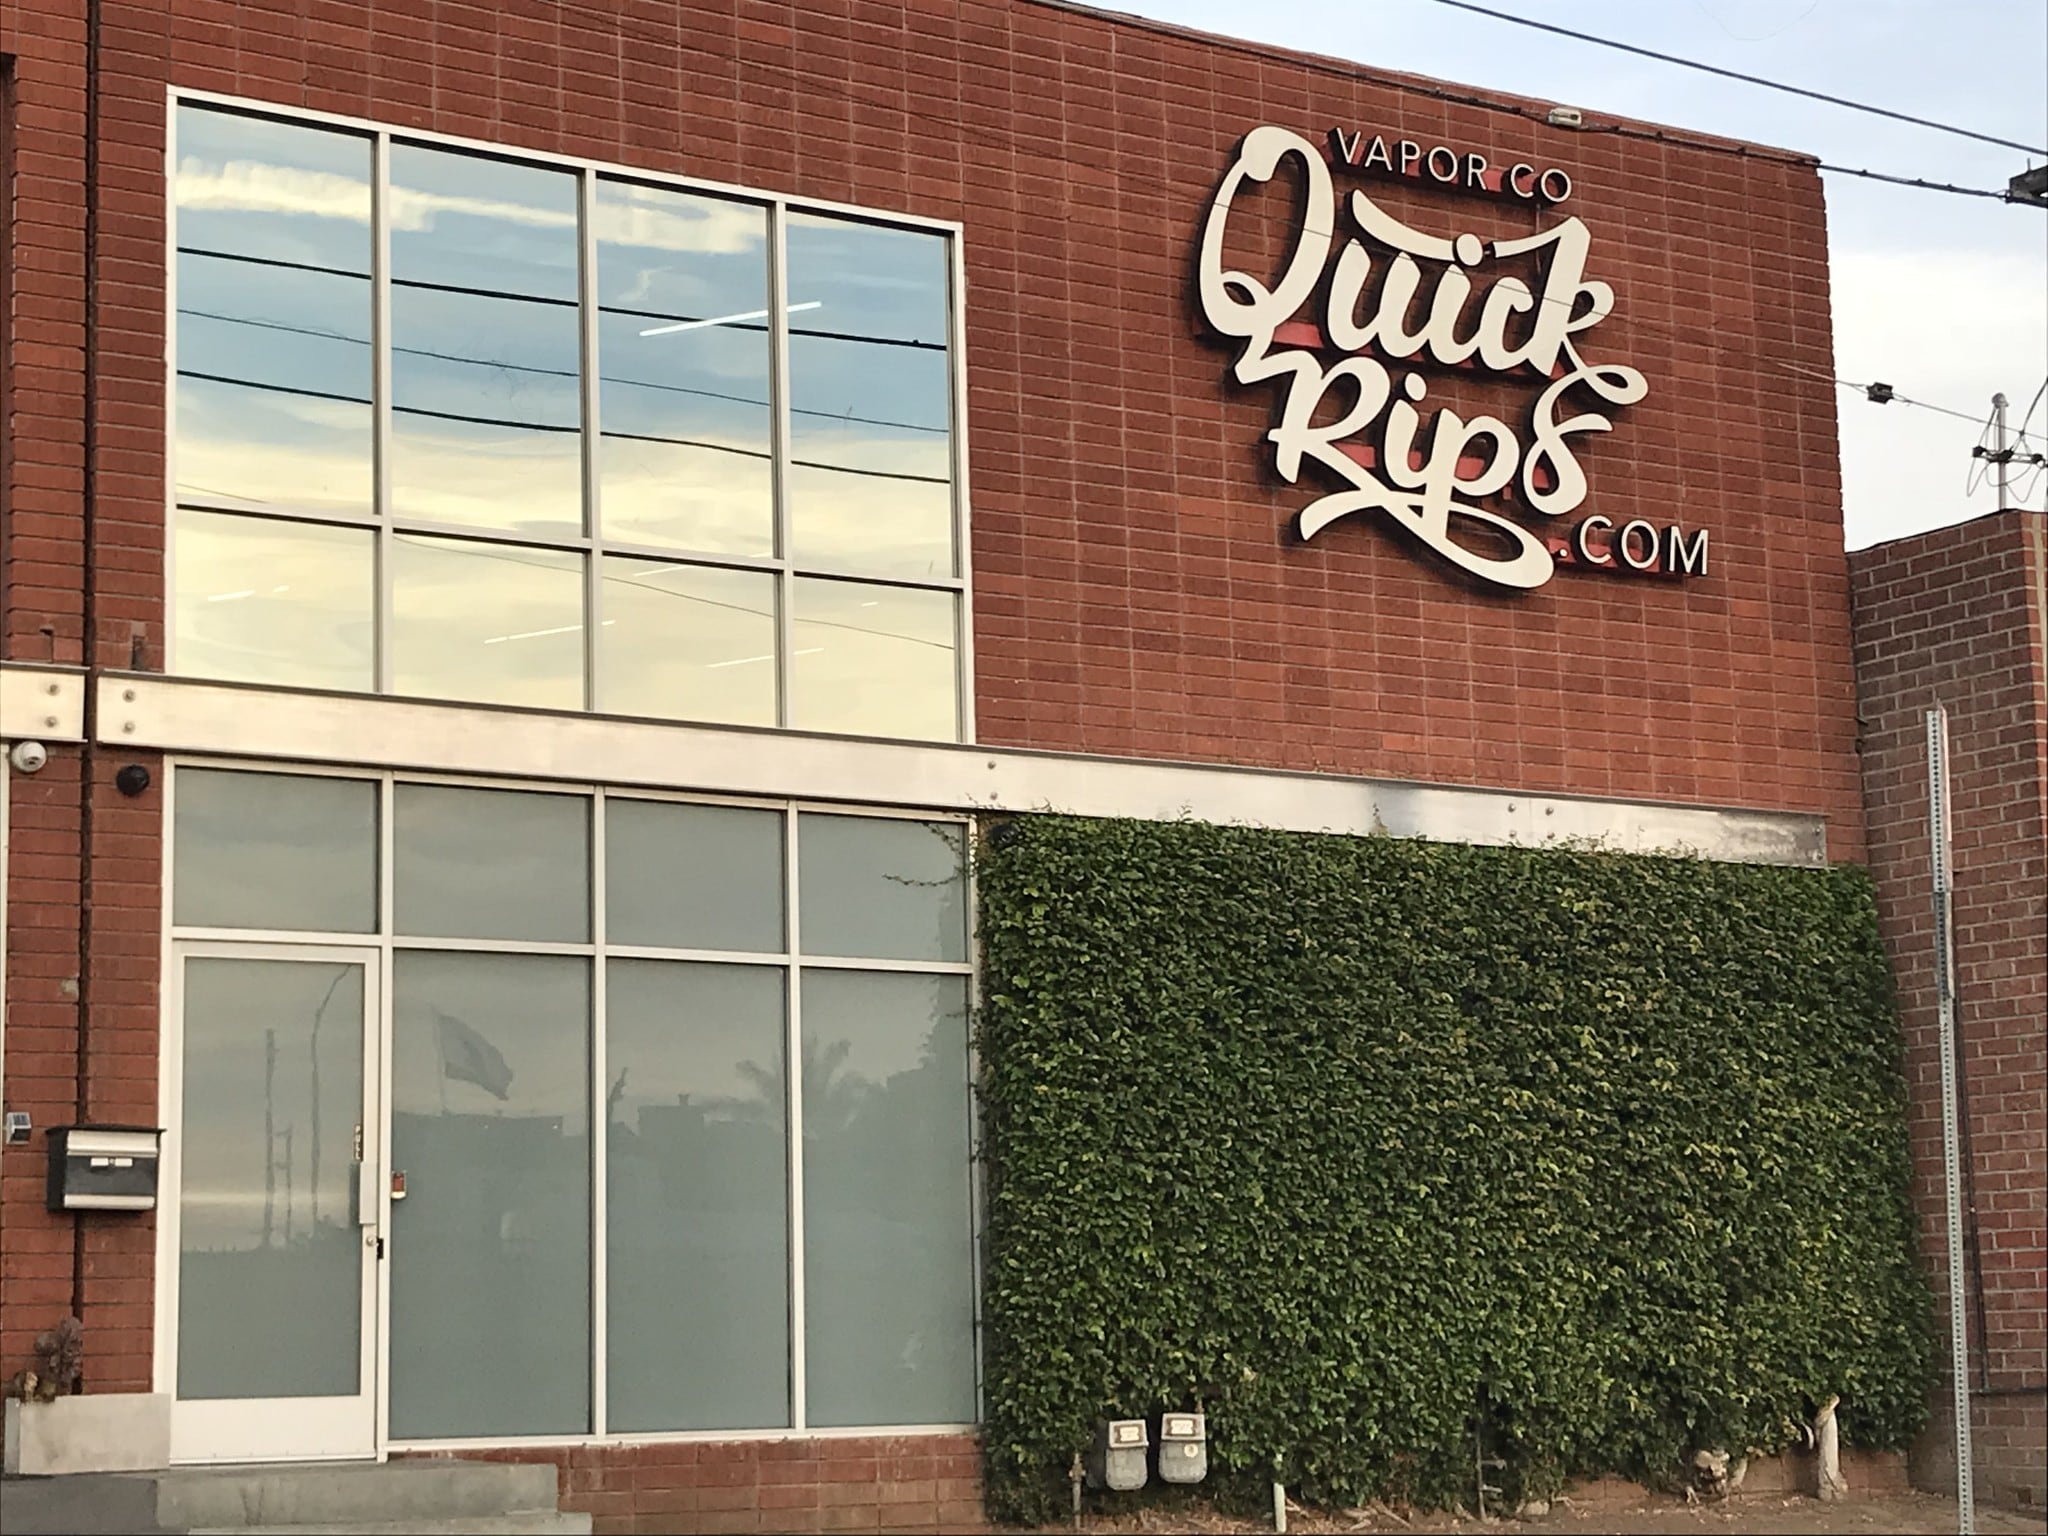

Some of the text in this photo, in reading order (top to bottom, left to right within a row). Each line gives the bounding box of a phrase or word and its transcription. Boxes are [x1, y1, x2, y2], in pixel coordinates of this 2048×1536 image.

[1335, 126, 1573, 204] VAPOR CO
[1200, 126, 1642, 384] Quick
[1236, 352, 1615, 588] Rips
[1558, 514, 1710, 576] .COM
